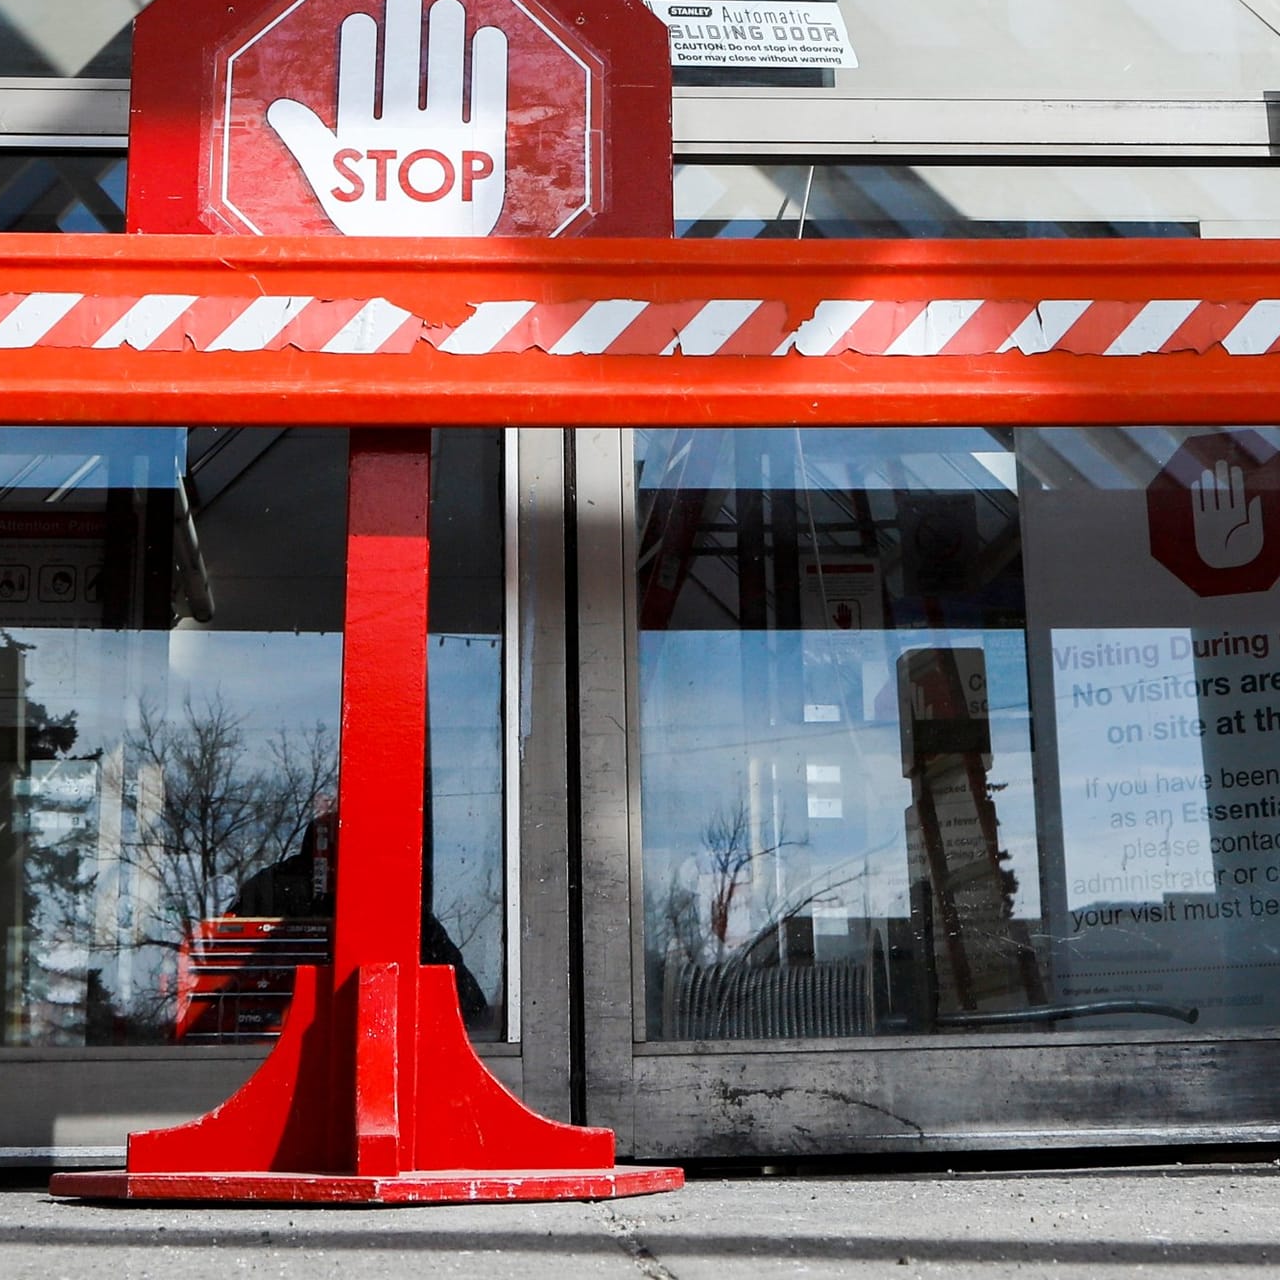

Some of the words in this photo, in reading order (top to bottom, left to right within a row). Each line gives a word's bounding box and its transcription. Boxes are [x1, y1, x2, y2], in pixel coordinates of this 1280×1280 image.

[670, 7, 711, 16] STANLEY
[722, 6, 818, 25] Automatic
[670, 24, 764, 40] SLIDING
[772, 26, 839, 42] DOOR
[674, 43, 727, 51] CAUTION:
[728, 43, 742, 51] Do
[763, 44, 786, 53] stop
[799, 45, 844, 54] doorway
[331, 148, 494, 202] STOP
[1052, 640, 1159, 670] Visiting
[1170, 632, 1269, 660] During
[1072, 683, 1112, 708] No
[1122, 674, 1231, 704] visitors
[1107, 723, 1143, 745] on
[1151, 715, 1207, 741] site
[1215, 710, 1246, 736] at
[1072, 906, 1123, 932] your
[1130, 901, 1177, 923] visit
[1184, 898, 1242, 921] must
[1250, 895, 1279, 916] be
